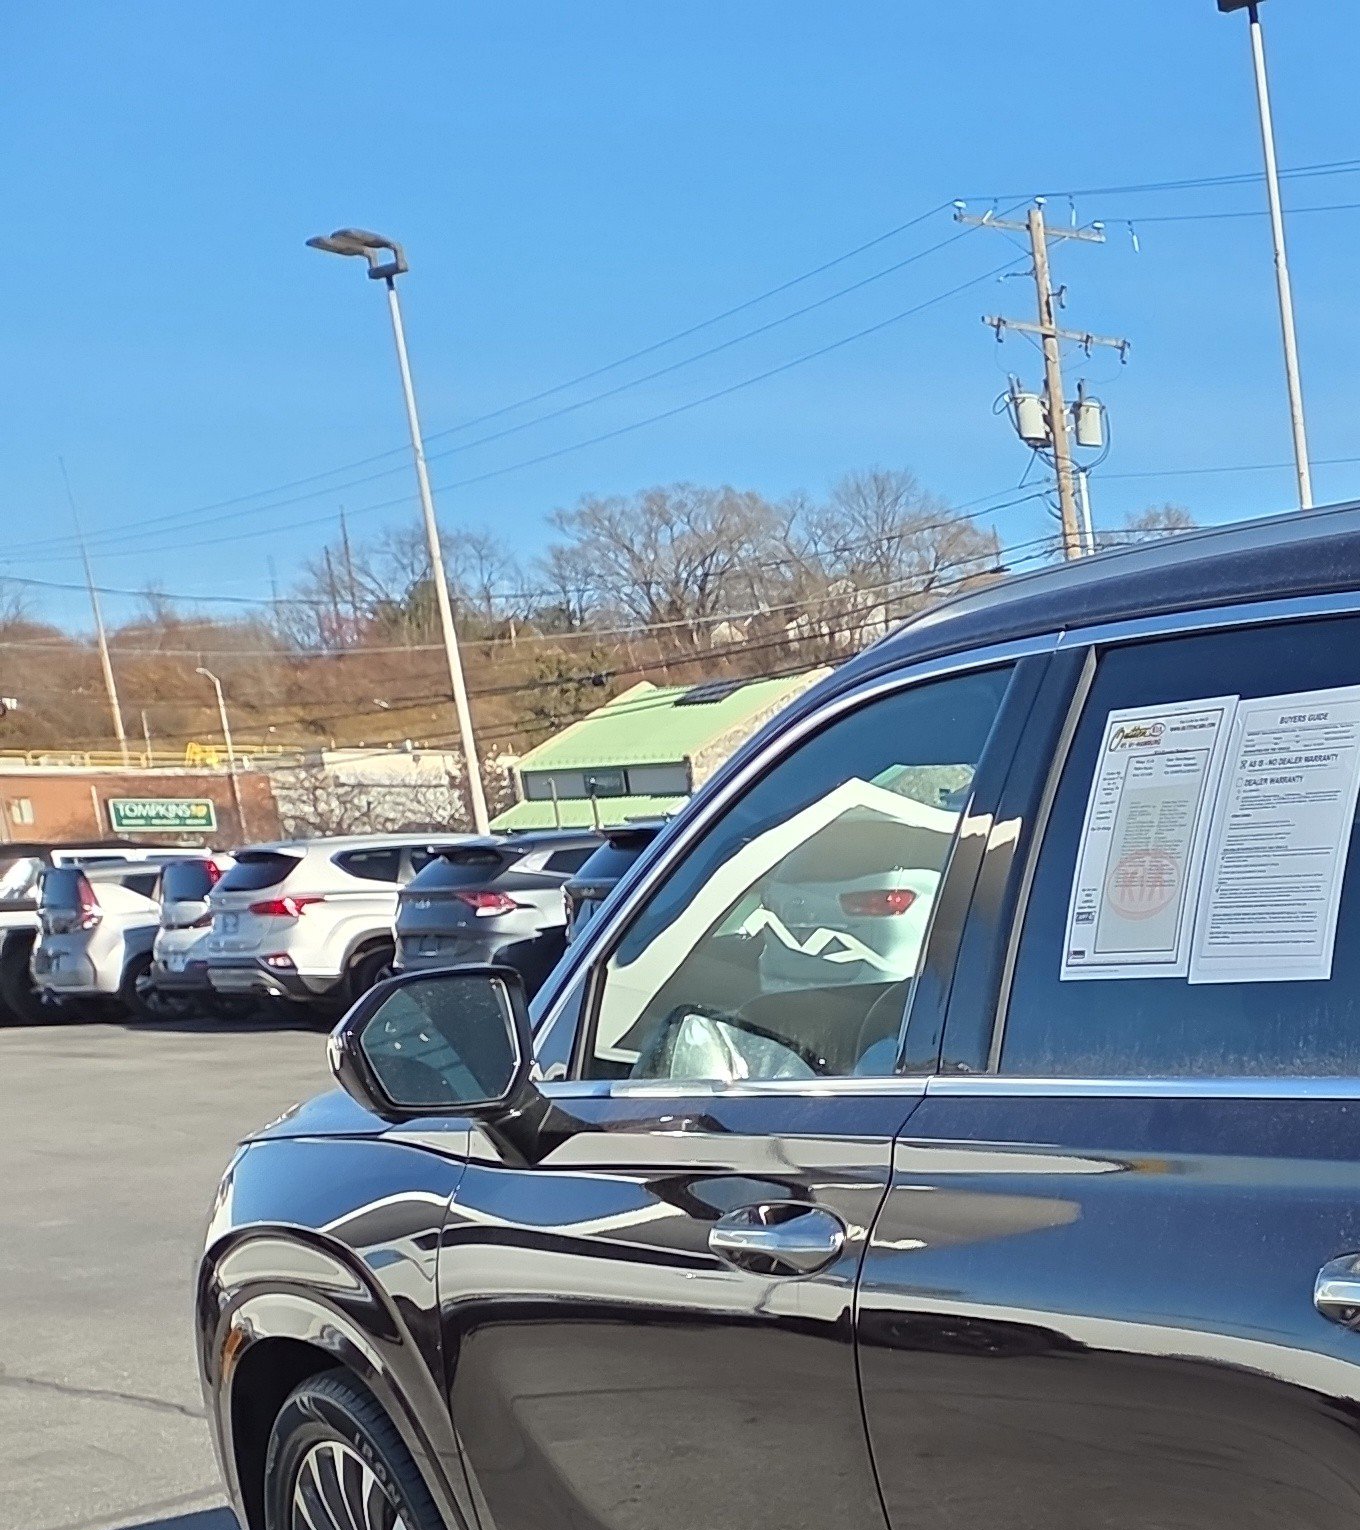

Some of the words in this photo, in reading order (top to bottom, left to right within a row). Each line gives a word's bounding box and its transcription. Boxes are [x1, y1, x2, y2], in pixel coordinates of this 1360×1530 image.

[1280, 714, 1307, 725] BUYERS
[1308, 712, 1329, 722] GUIDE
[1280, 756, 1303, 766] DEALER
[1304, 753, 1339, 764] WARRANTY
[1244, 778, 1269, 787] DEALER
[1269, 775, 1304, 785] WARRANTY
[115, 803, 191, 818] TOMPKINS
